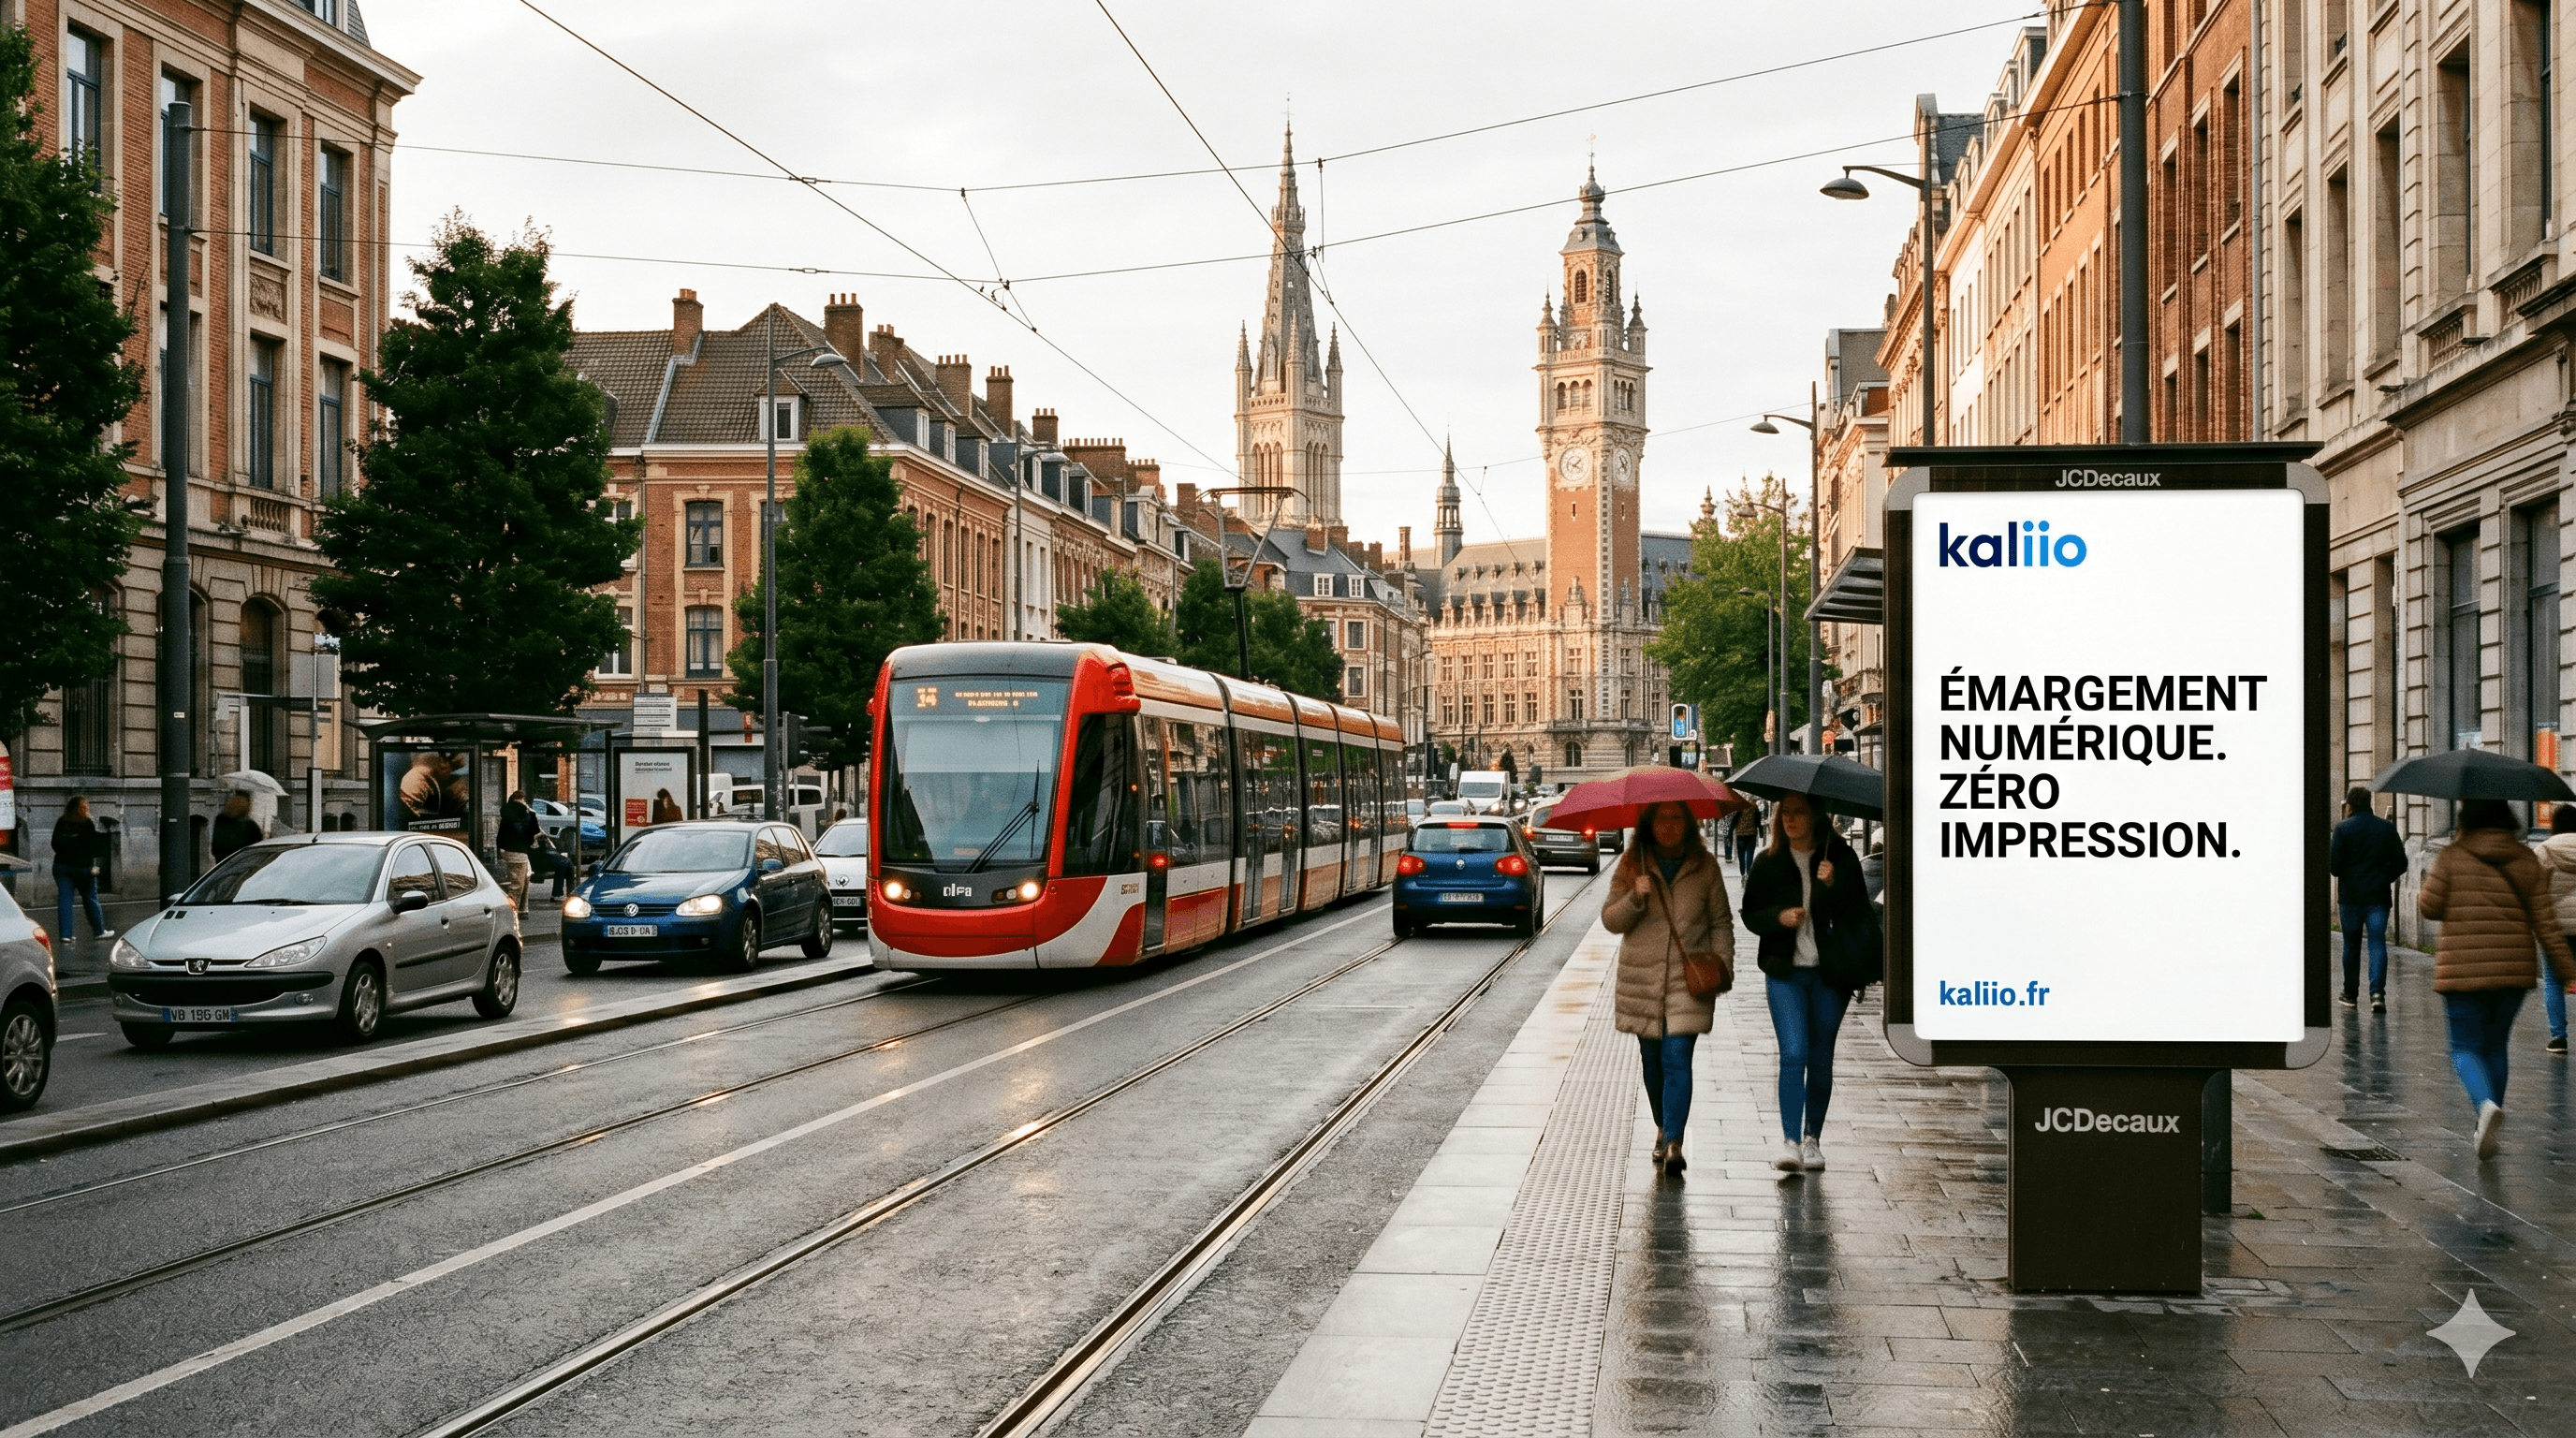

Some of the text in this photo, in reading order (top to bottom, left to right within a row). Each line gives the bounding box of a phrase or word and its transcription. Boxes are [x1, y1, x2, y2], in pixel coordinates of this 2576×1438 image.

[2055, 468, 2162, 488] JCDecaux
[1939, 520, 2087, 568] kaliio
[1940, 666, 2268, 712] ÉMARGEMENT
[1940, 715, 2227, 766] NUMÉRIQUE.
[1939, 765, 2060, 810] ZÉRO
[1940, 821, 2241, 858] IMPRESSION.
[1939, 979, 2051, 1006] kaliio.fr
[2034, 1107, 2181, 1134] JCDecaux
